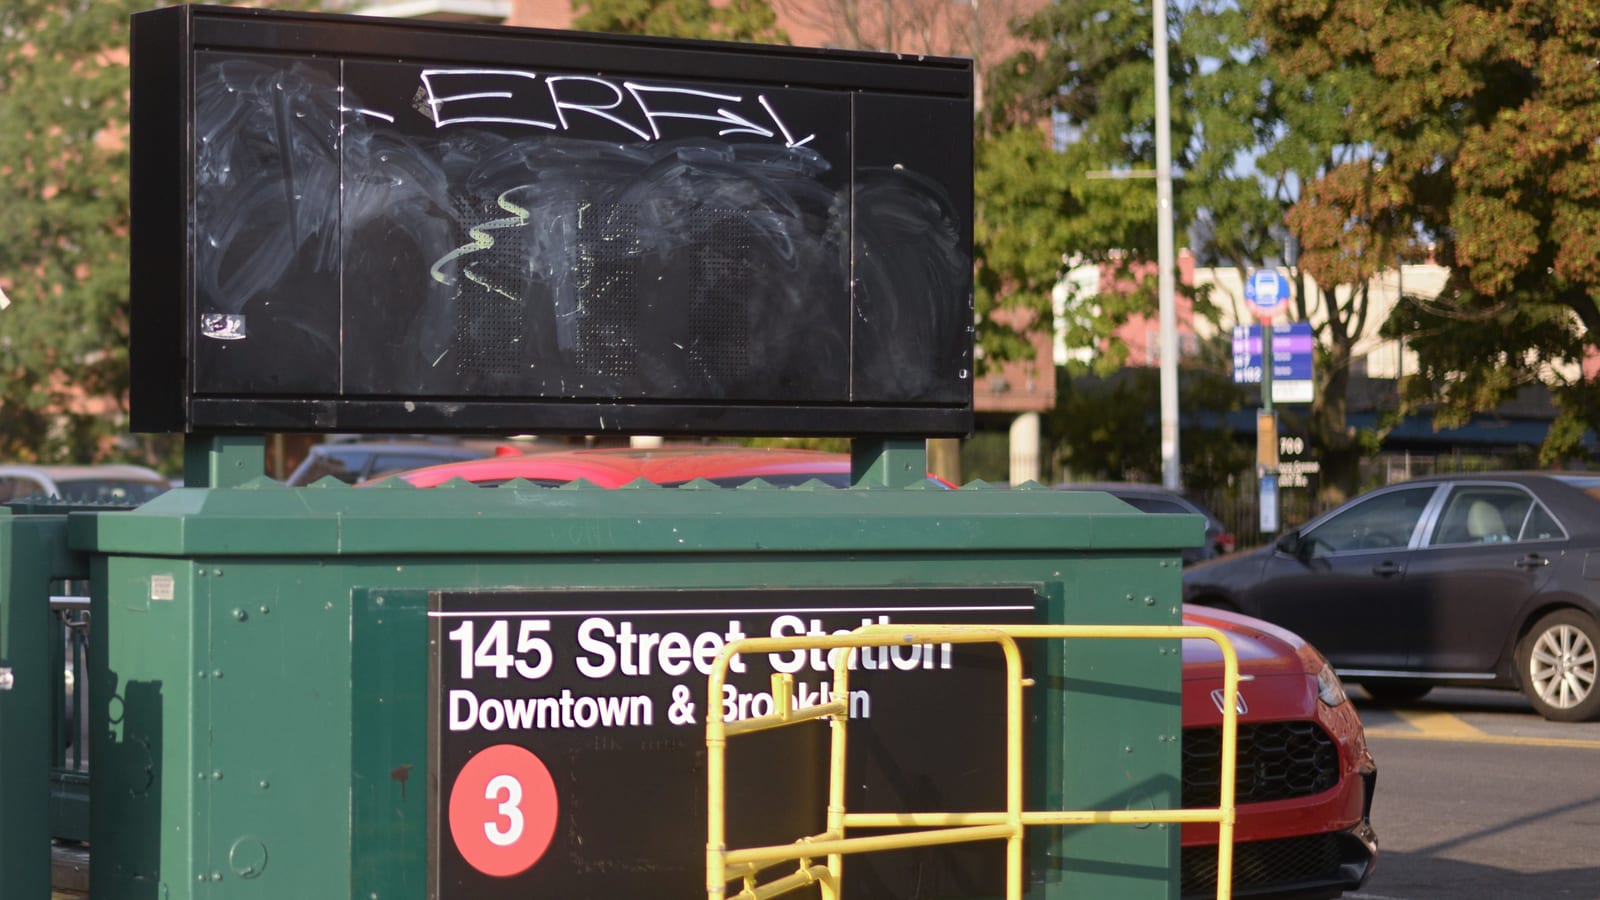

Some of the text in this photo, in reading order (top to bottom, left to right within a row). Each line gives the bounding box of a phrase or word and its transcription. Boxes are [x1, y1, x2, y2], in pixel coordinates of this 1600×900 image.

[449, 619, 553, 679] 145
[575, 617, 746, 678] Street
[449, 682, 870, 731] Downtown & Brokln
[483, 774, 525, 846] 3
